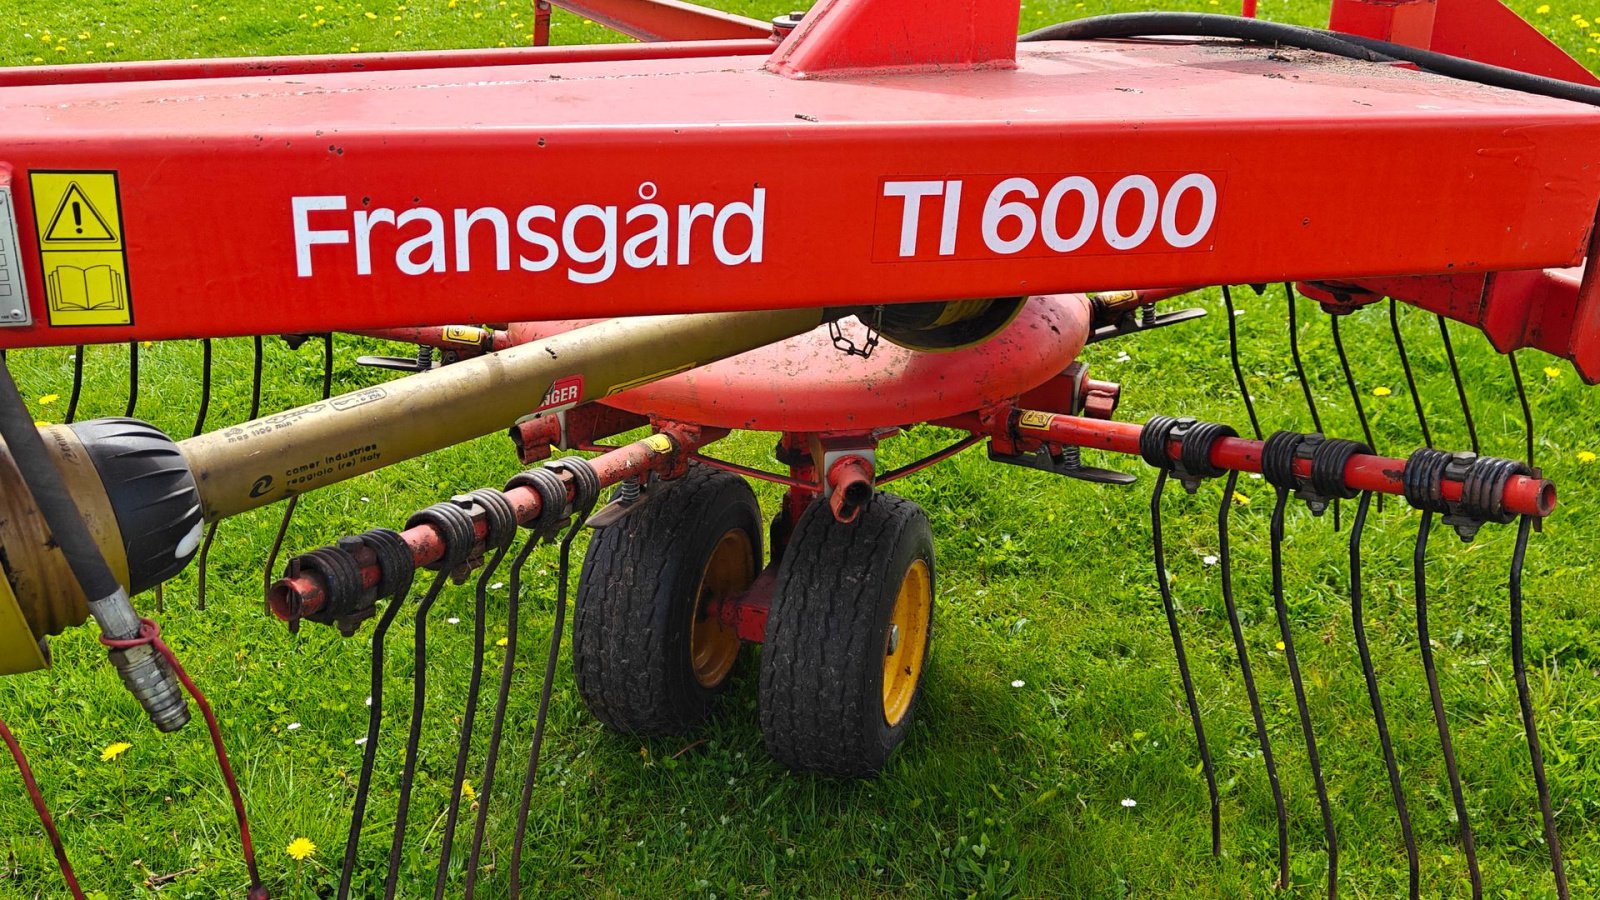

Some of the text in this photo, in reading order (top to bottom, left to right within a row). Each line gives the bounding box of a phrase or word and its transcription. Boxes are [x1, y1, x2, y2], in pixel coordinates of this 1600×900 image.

[883, 172, 1217, 257] TI 6000
[291, 181, 766, 284] Fransgård
[541, 385, 578, 408] NGER
[325, 443, 377, 465] industries
[360, 452, 381, 464] italy
